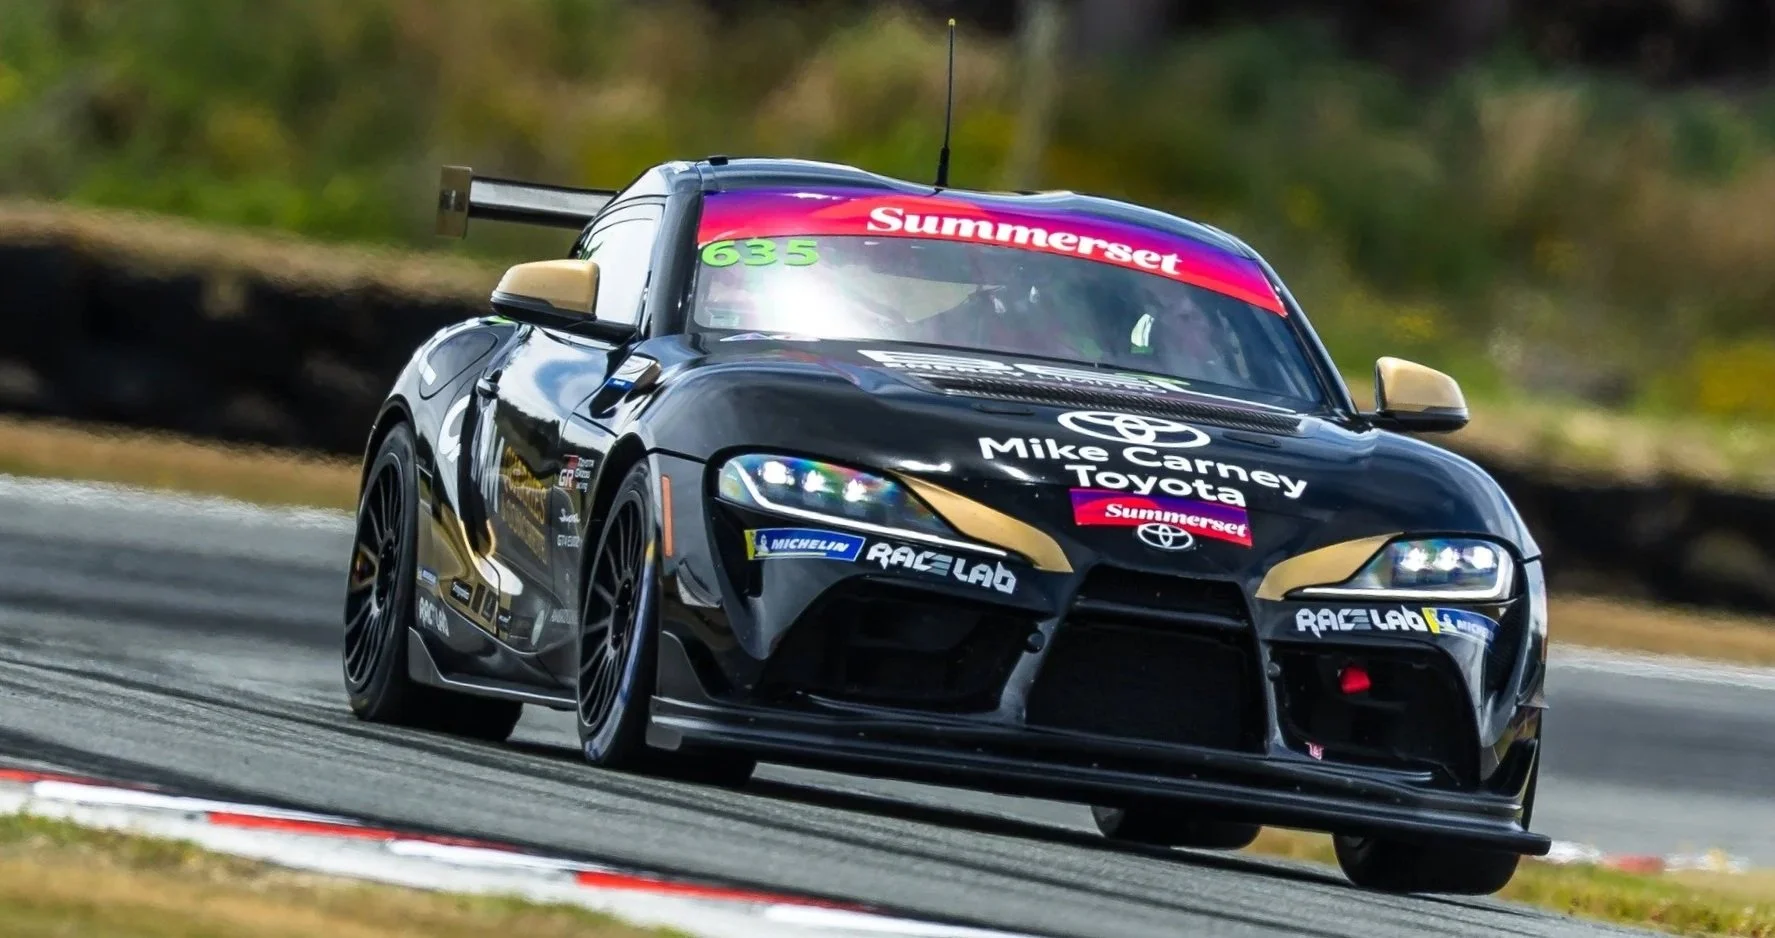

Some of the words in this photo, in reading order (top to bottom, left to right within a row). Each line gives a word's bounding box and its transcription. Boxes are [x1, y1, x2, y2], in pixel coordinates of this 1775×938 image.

[701, 239, 820, 268] 635
[866, 206, 1184, 276] Summerset
[558, 468, 575, 488] GR
[977, 436, 1109, 461] Mike
[1122, 447, 1308, 499] Carney
[1064, 464, 1247, 507] Toyota
[1104, 503, 1248, 538] Summerset
[770, 537, 851, 553] MICHELIN
